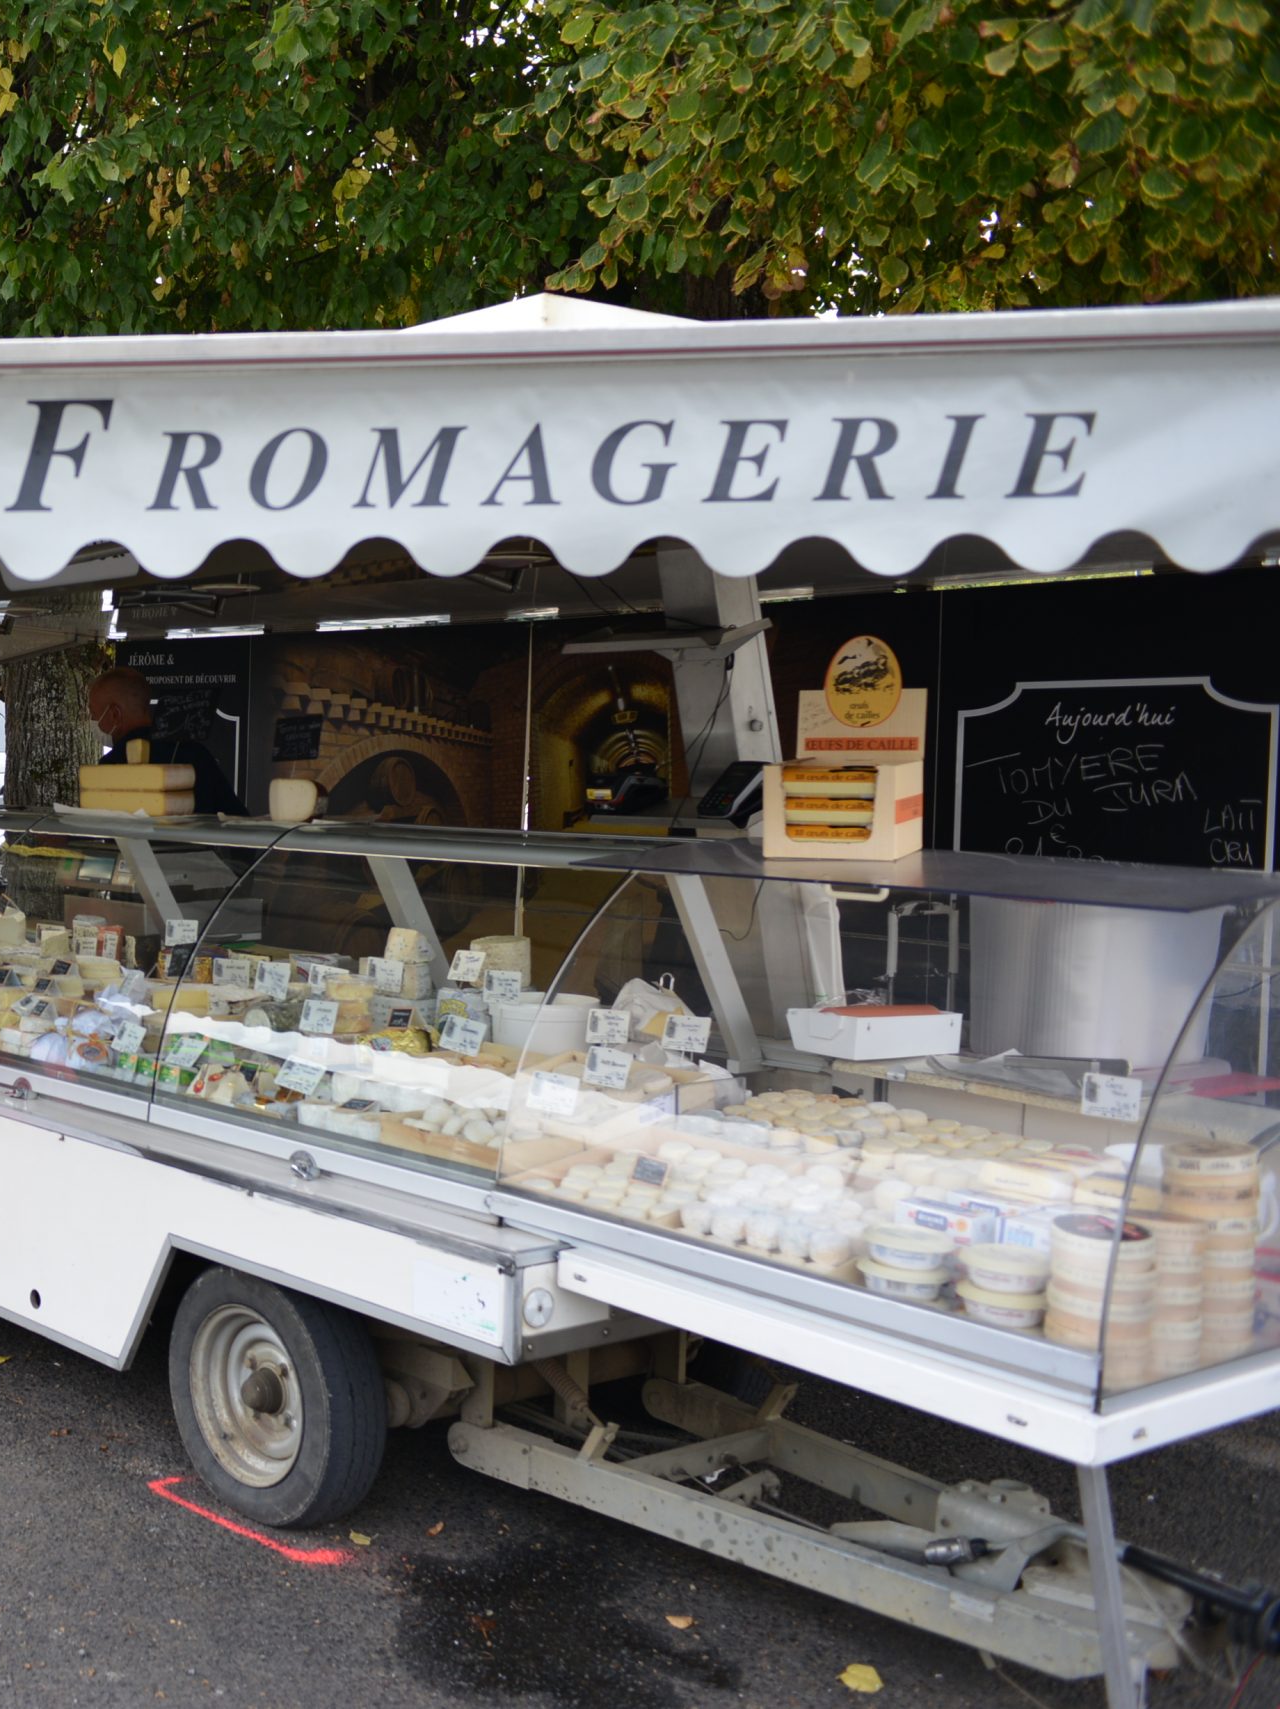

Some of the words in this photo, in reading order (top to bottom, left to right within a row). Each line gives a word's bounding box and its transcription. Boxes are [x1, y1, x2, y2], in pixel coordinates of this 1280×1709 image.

[4, 398, 1097, 512] FROMAGERIE
[128, 652, 165, 667] JÉRÔME
[167, 654, 174, 665] &
[185, 675, 194, 684] DE
[195, 673, 236, 684] DÉCOUVRIR
[845, 711, 854, 720] de
[1045, 701, 1176, 744] Aujourd'hui
[845, 739, 863, 750] DE
[866, 738, 916, 750] CAILLE
[1021, 798, 1071, 825] DU
[1093, 771, 1198, 812] JURA
[1204, 799, 1262, 834] LAIT
[1210, 838, 1253, 866] CRU
